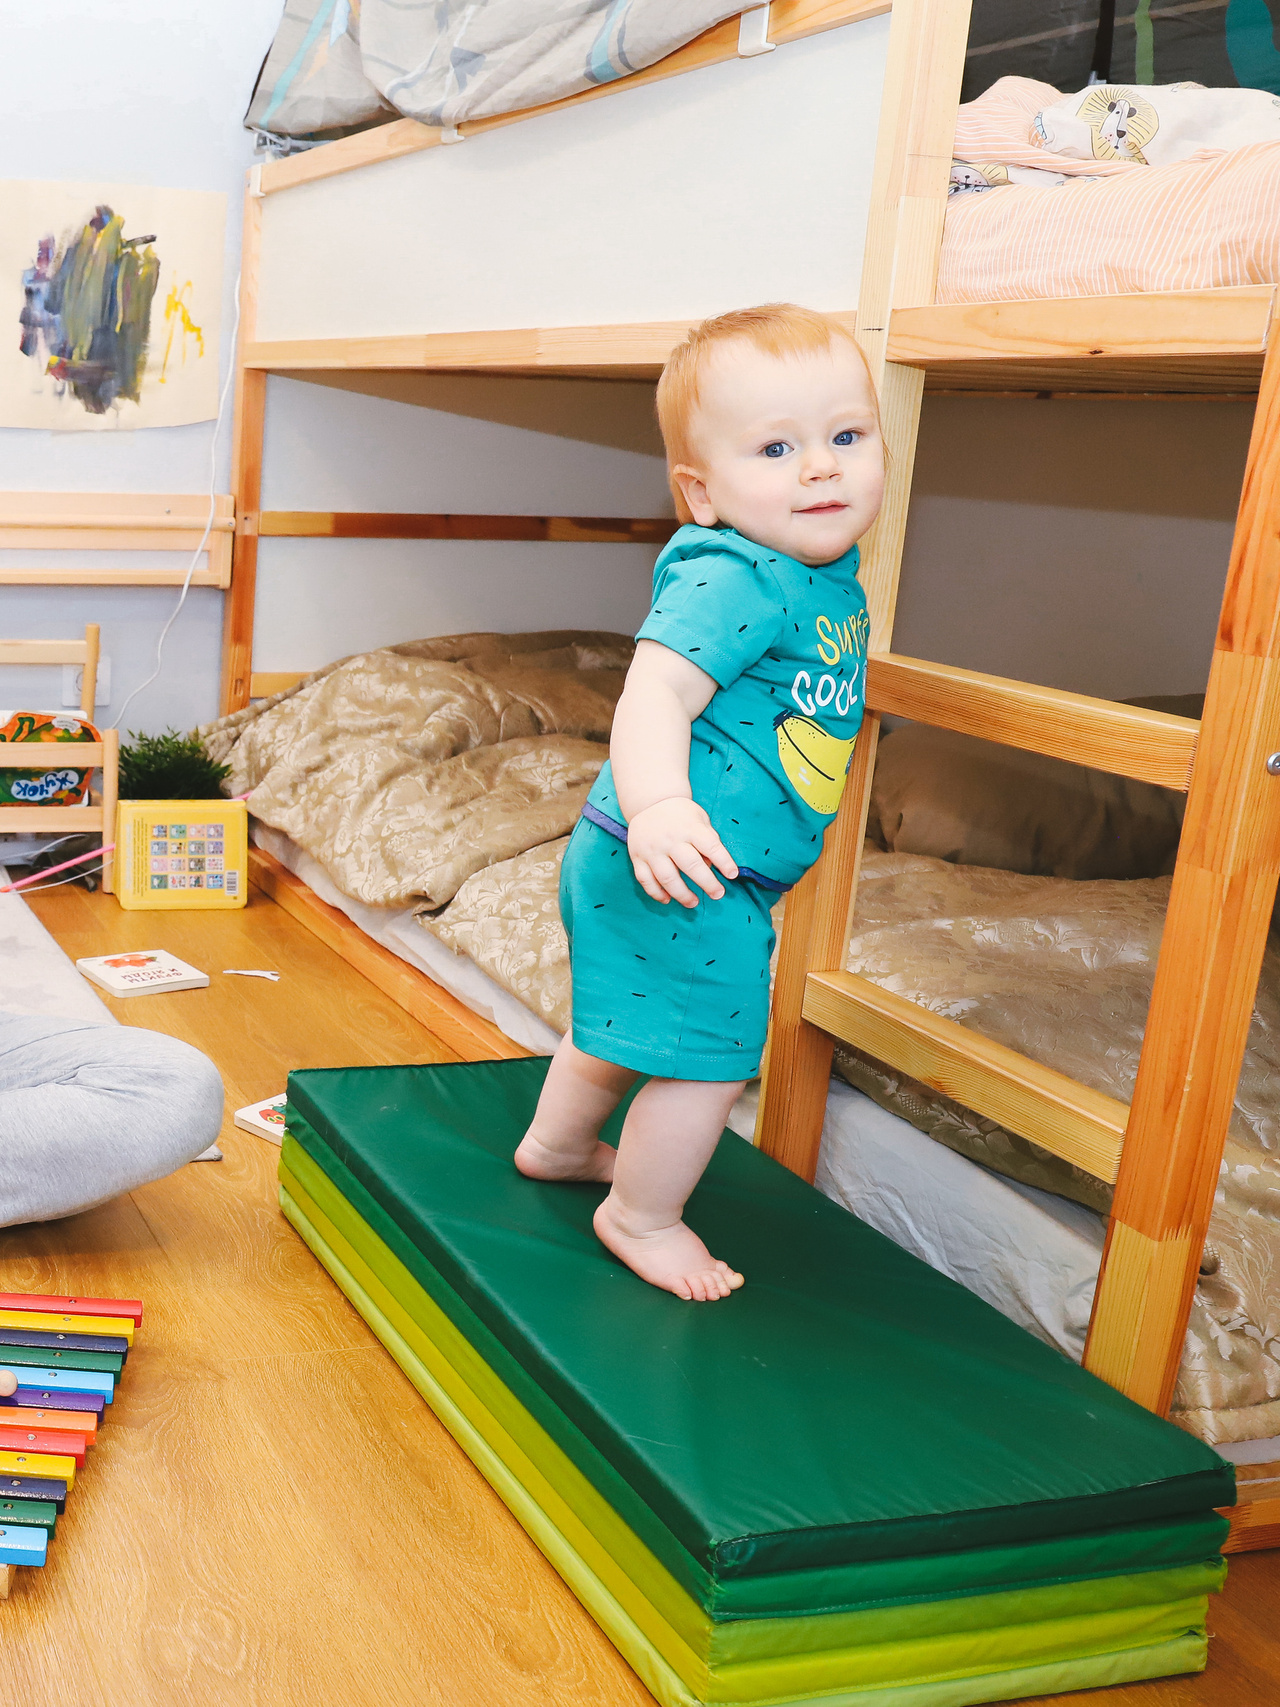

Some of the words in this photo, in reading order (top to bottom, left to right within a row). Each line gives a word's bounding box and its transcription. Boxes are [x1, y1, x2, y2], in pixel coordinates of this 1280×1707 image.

[791, 663, 859, 717] COOL
[121, 969, 165, 980] ЯГОДЫ
[128, 972, 173, 983] ФРУКТЫ
